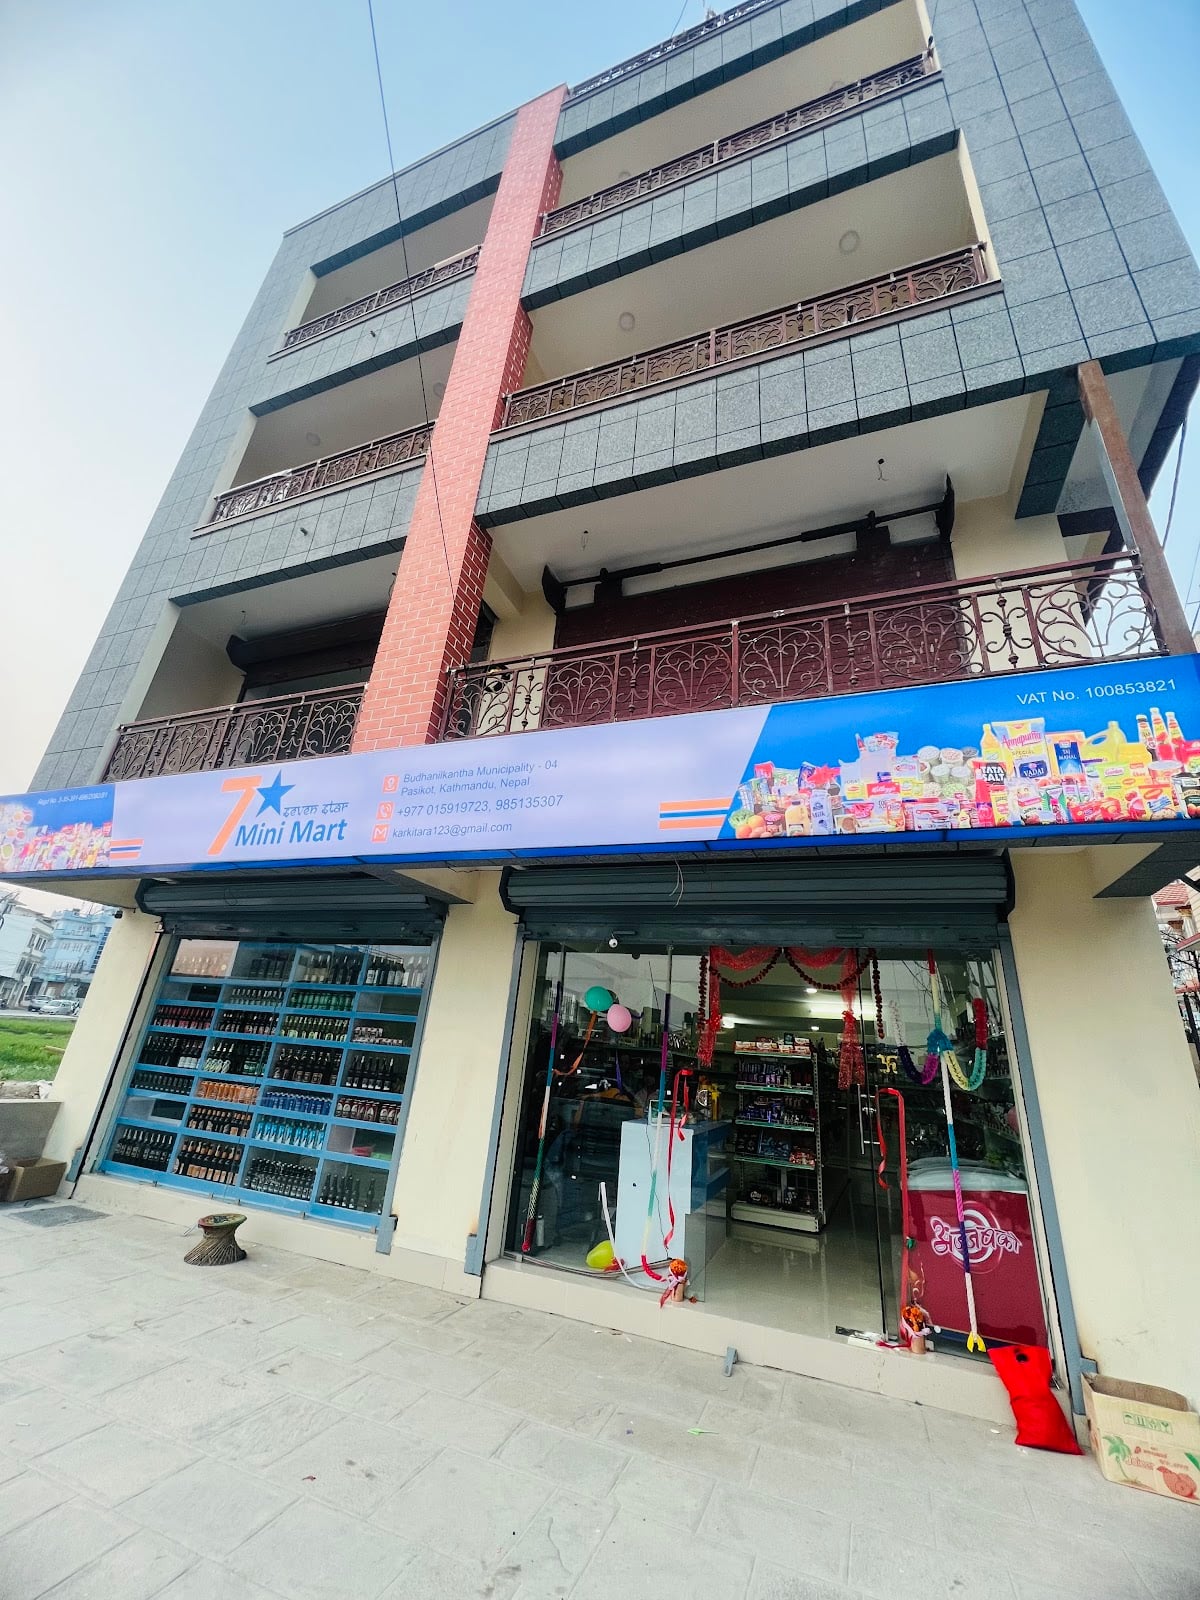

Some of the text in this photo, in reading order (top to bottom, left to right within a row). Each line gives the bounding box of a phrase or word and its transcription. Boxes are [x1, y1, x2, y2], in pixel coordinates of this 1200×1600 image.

[1016, 679, 1176, 705] VAT No. 100853821
[403, 769, 474, 783] Budhanilkantha
[476, 762, 535, 775] Municipality
[544, 760, 558, 770] 04
[500, 777, 530, 789] Nepal
[207, 775, 262, 855] 7
[397, 804, 424, 817] +977
[235, 818, 347, 847] Mini Mart
[392, 823, 513, 838] karkitara123@gmail.com
